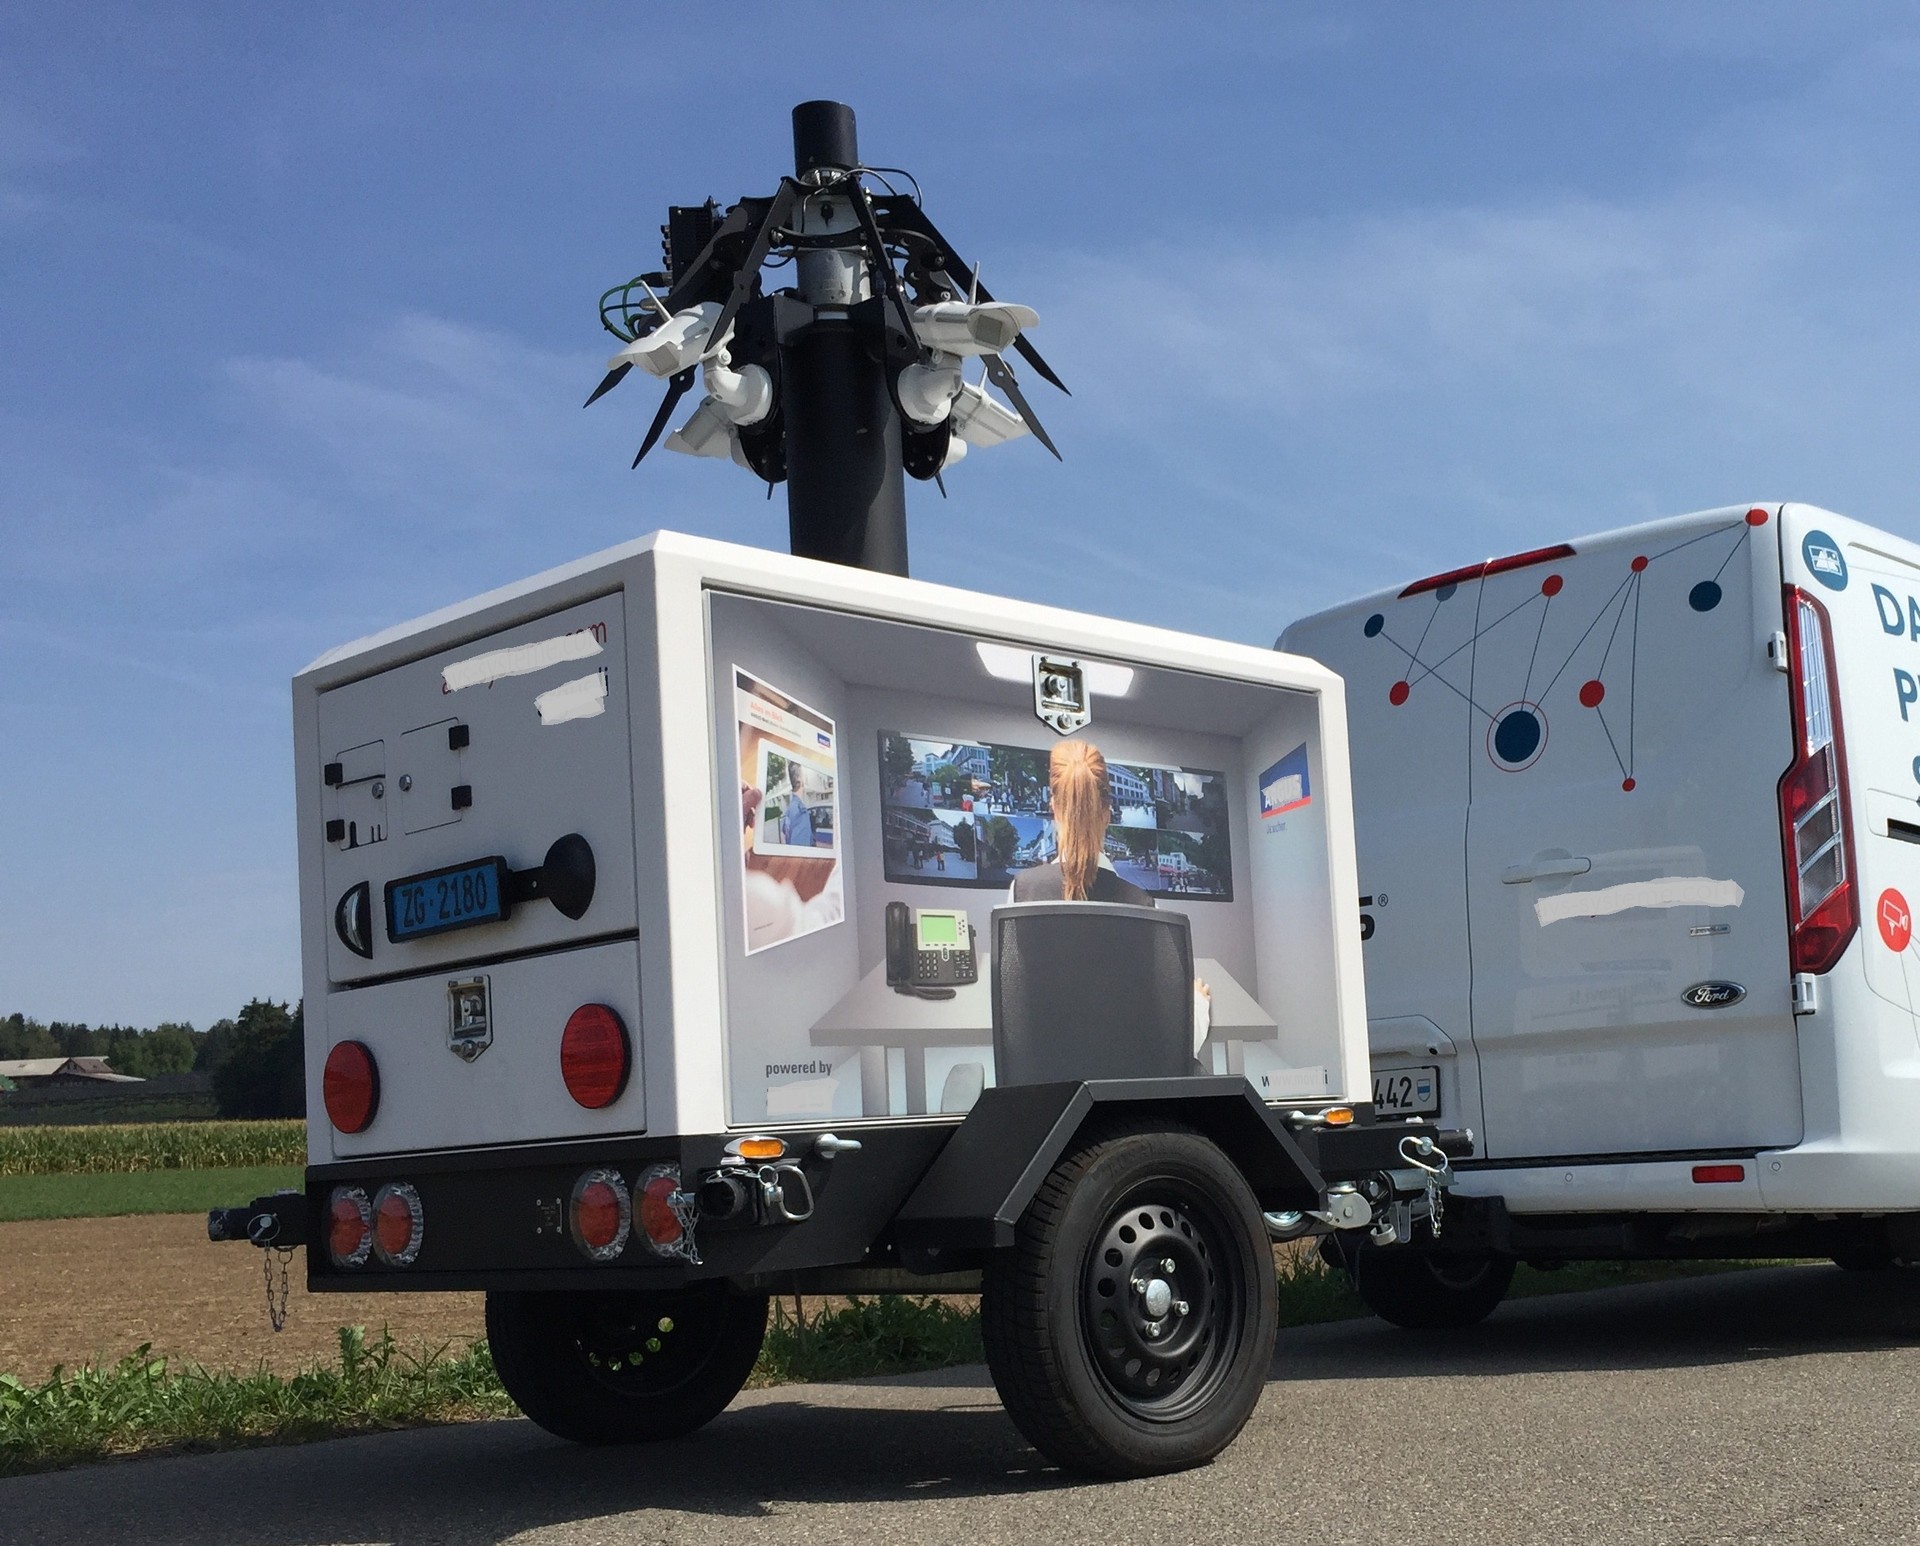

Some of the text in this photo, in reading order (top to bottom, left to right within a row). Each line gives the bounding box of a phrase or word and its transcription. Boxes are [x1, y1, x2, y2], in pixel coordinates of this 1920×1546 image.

[1893, 667, 1920, 722] P
[437, 871, 488, 920] 2180
[1694, 985, 1730, 1003] Ford
[766, 1060, 833, 1078] powered by
[1372, 1076, 1413, 1110] 442
